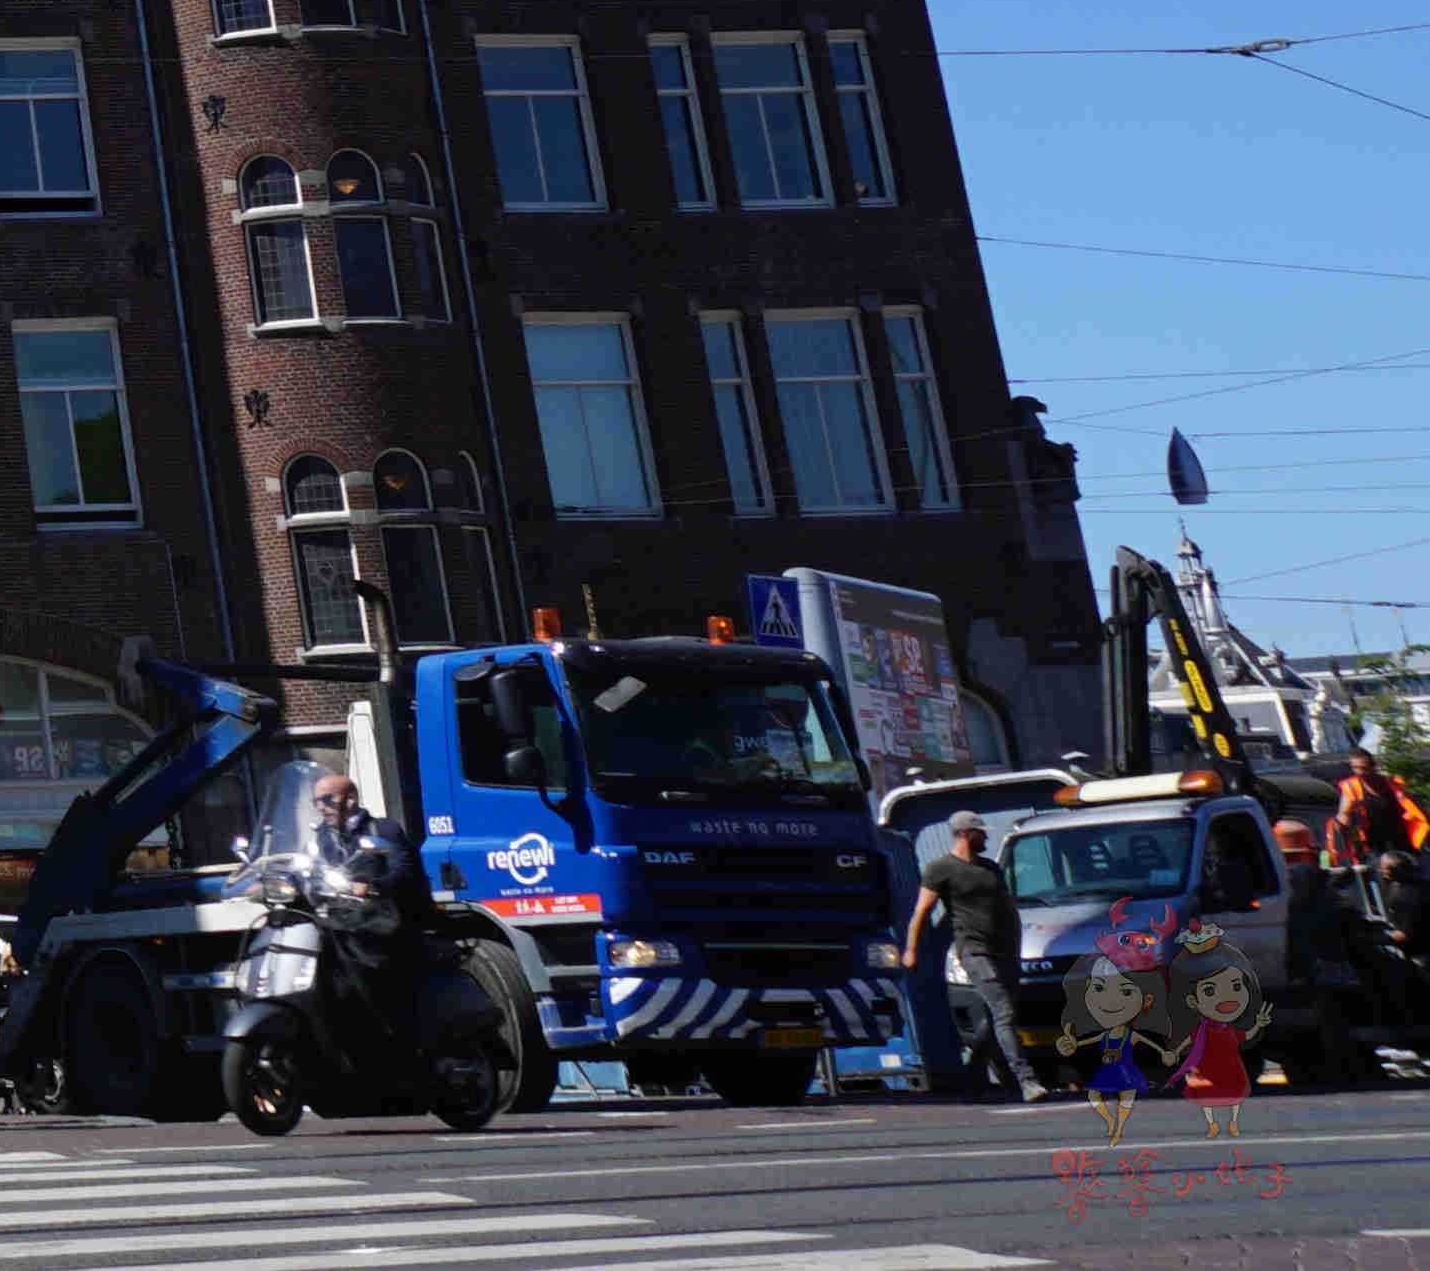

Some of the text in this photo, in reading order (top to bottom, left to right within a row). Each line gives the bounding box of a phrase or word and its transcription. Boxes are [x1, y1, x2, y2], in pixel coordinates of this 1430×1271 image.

[428, 816, 455, 835] 6051
[689, 818, 818, 836] waste no more
[487, 842, 555, 871] renewi
[643, 851, 868, 868] DAF CF
